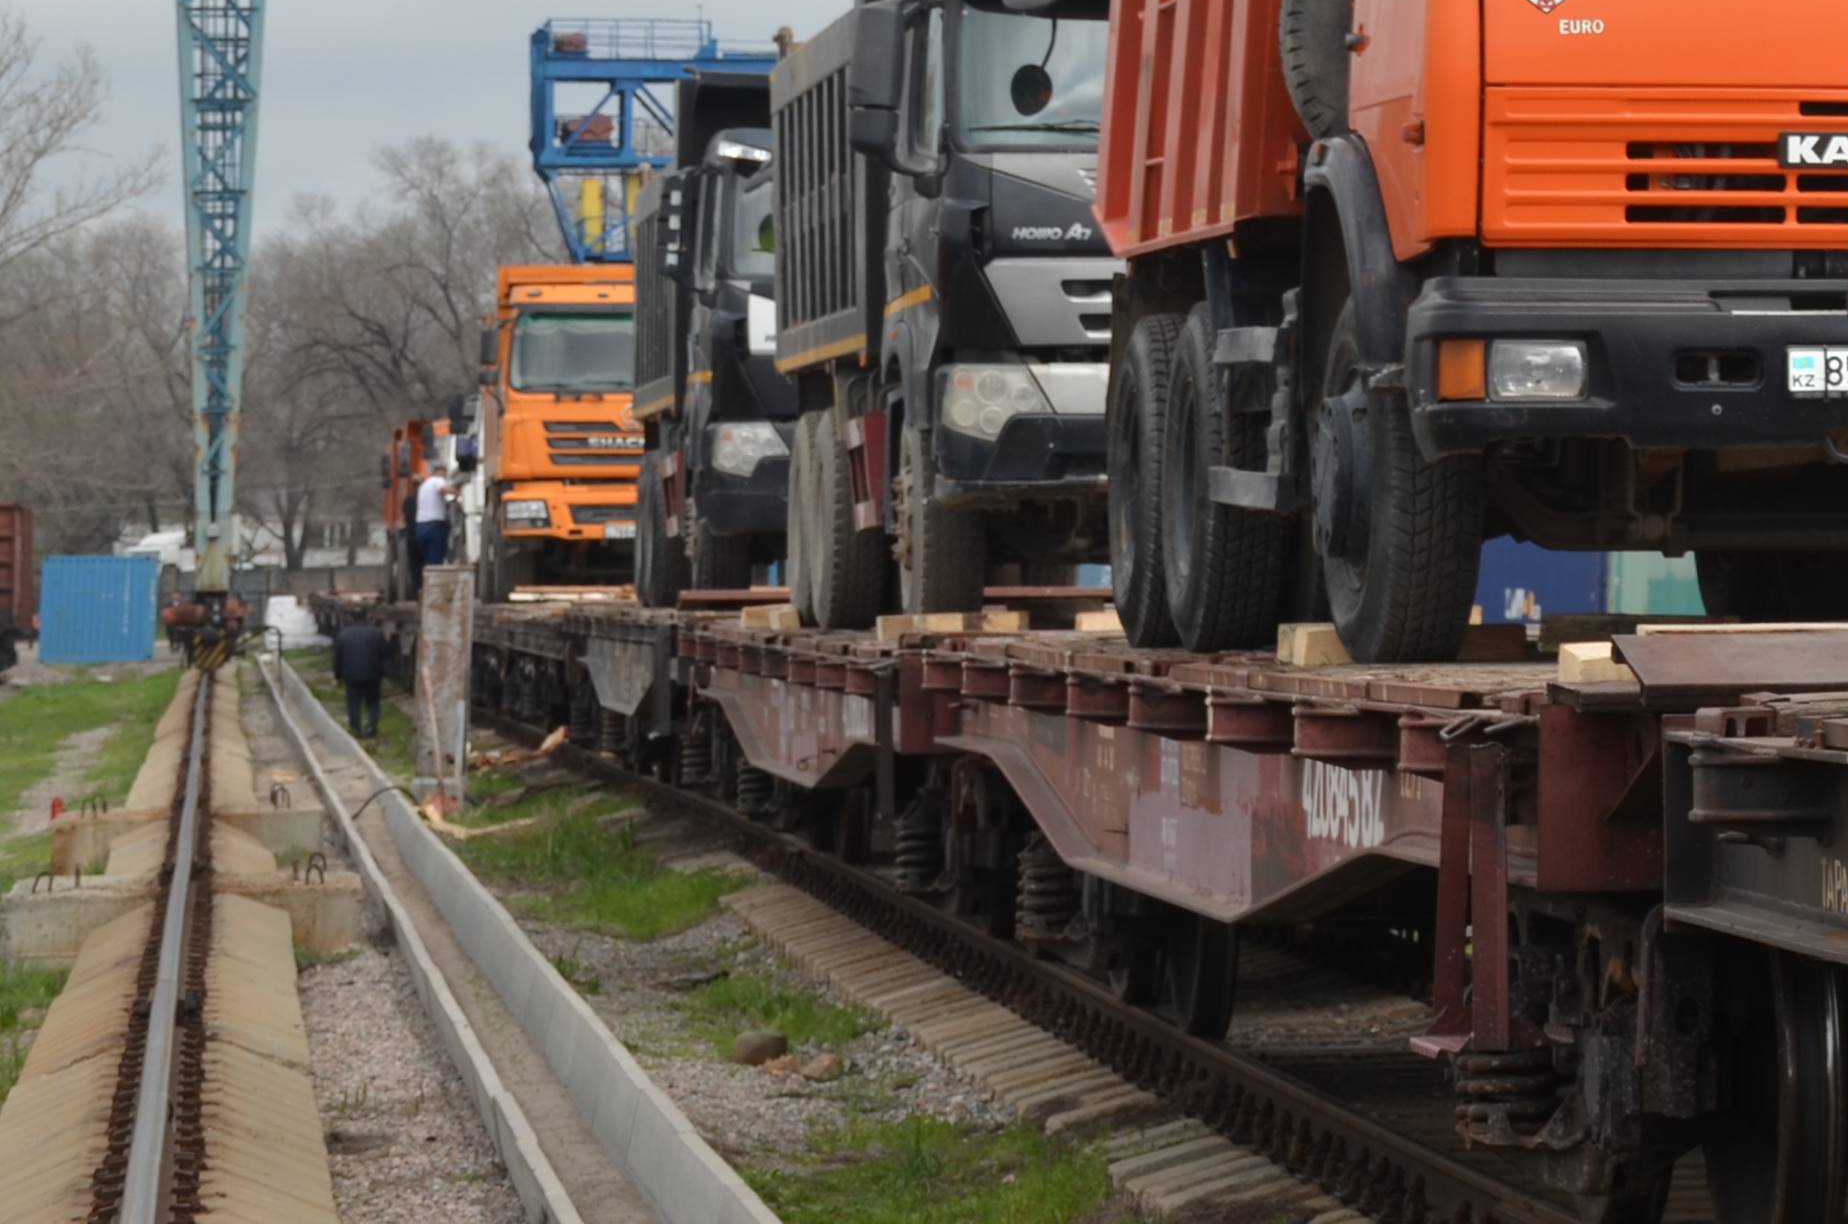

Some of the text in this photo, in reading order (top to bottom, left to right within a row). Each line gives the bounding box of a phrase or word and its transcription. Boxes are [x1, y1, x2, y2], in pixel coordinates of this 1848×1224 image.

[1559, 18, 1605, 35] EURO
[1012, 226, 1063, 241] HOWO
[1792, 374, 1815, 388] KZ
